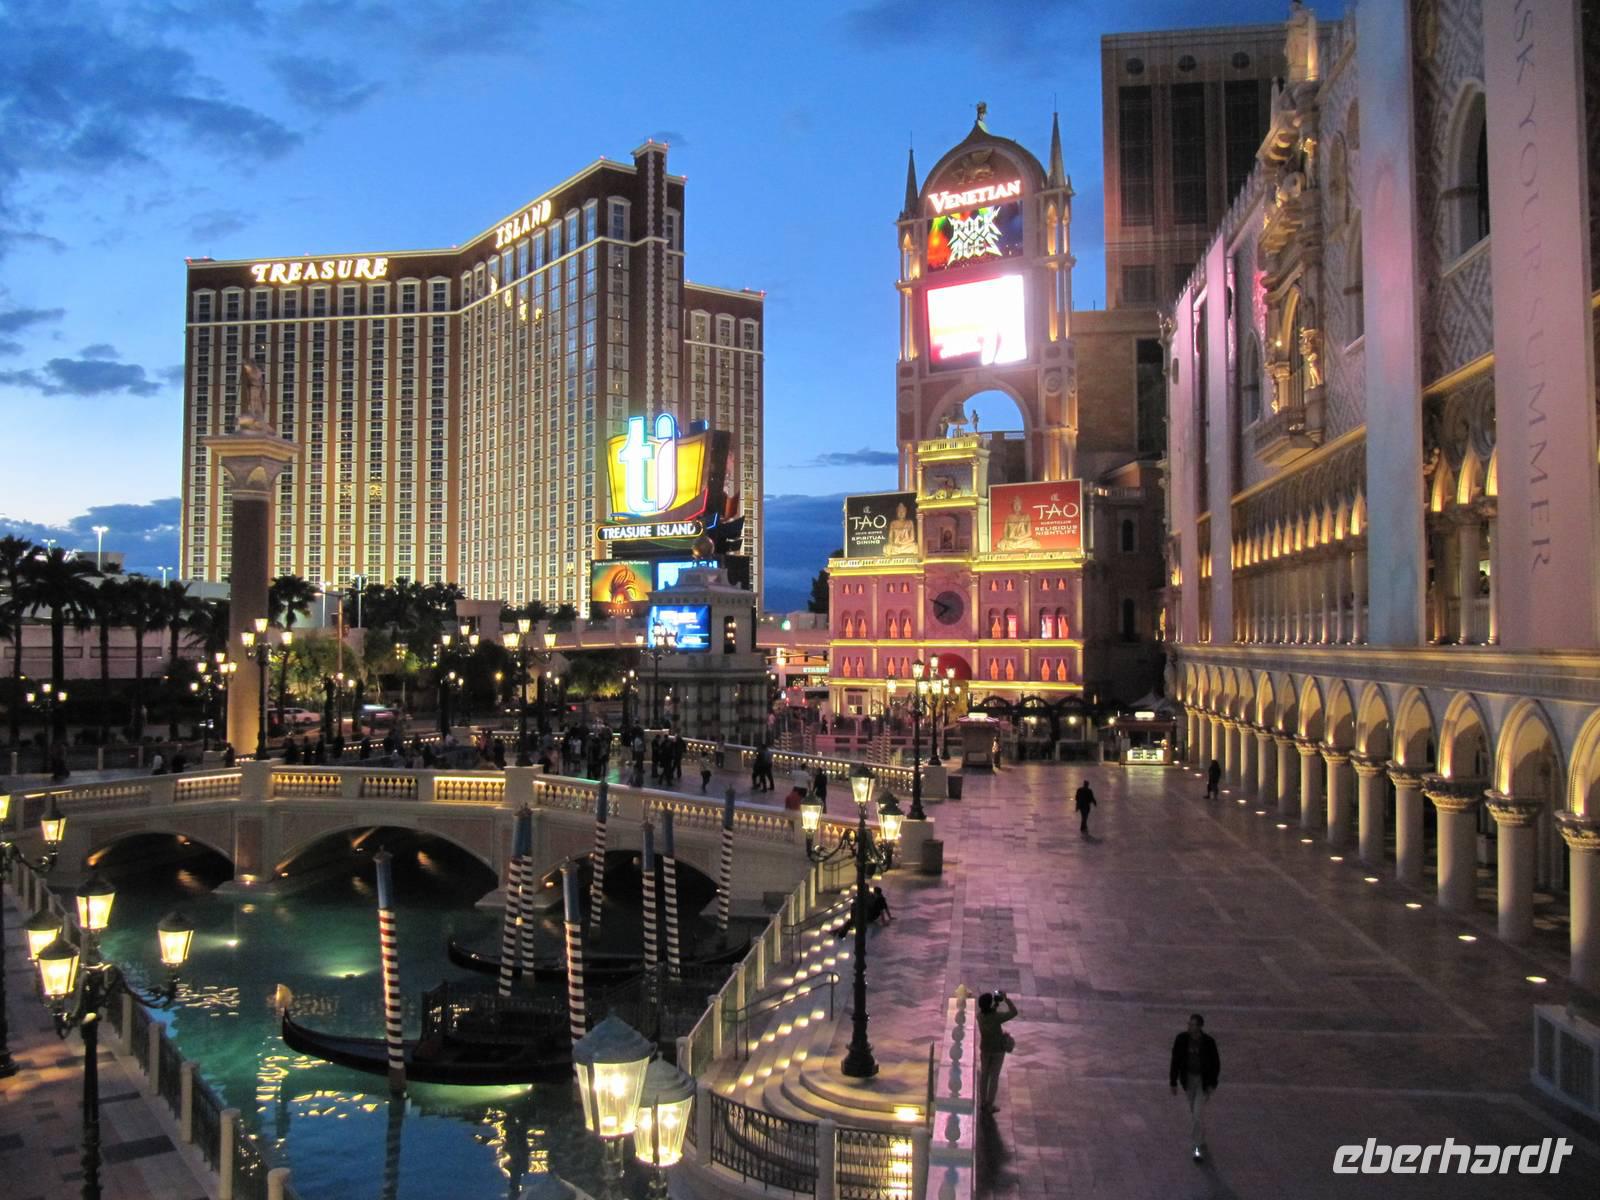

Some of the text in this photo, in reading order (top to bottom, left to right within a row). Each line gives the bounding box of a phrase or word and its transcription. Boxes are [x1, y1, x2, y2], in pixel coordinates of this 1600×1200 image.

[928, 180, 1021, 213] VENETIAN
[1519, 90, 1542, 272] YOUR
[251, 199, 552, 284] TREASURE ISLAND
[947, 206, 1003, 247] ROCK
[947, 232, 1003, 266] AGES
[1526, 294, 1550, 574] SUMMER
[849, 514, 887, 531] TAO
[1032, 503, 1079, 520] TAO
[602, 522, 697, 540] TREASURE ISLAND
